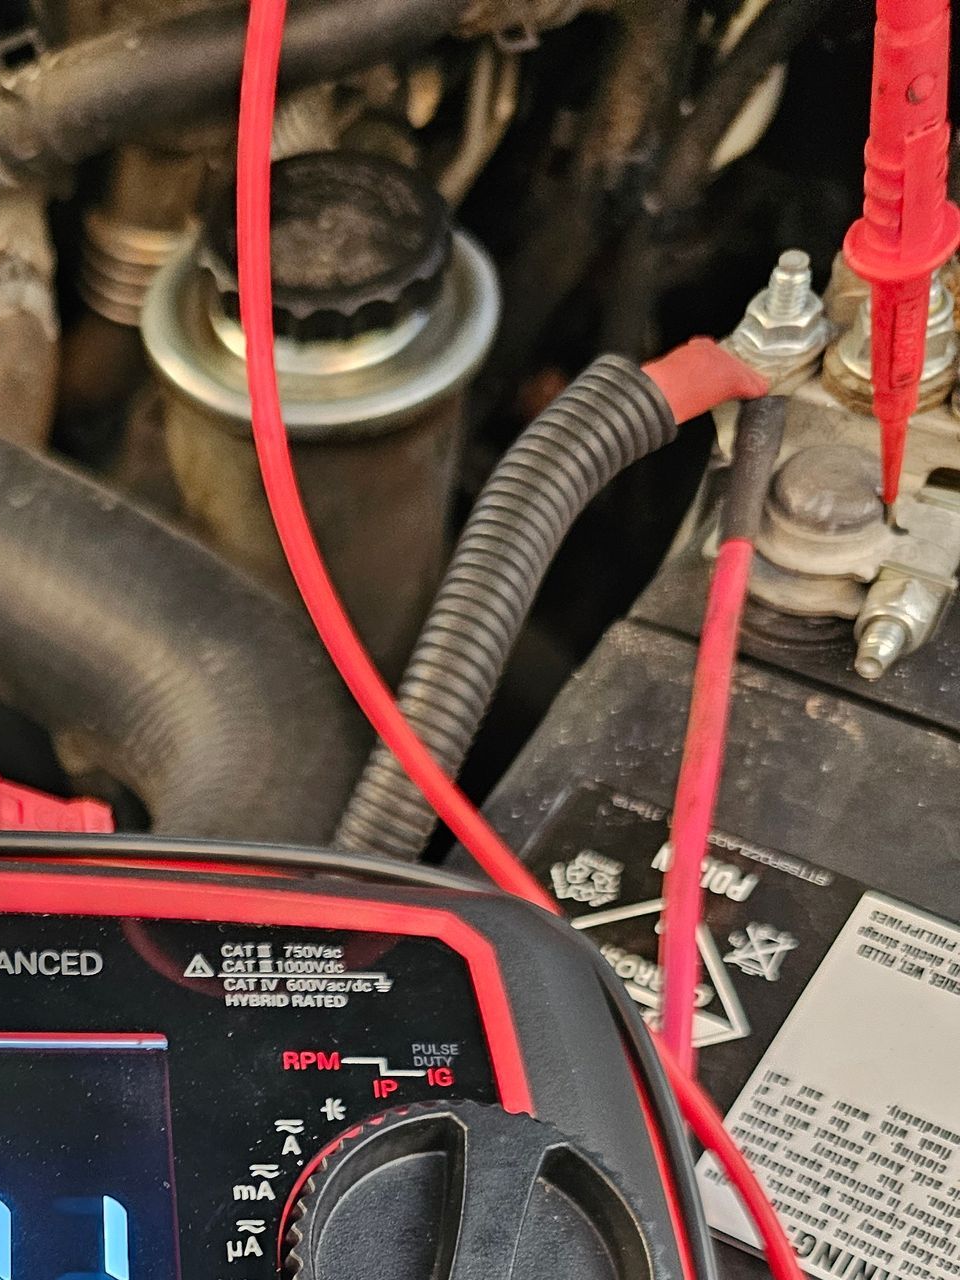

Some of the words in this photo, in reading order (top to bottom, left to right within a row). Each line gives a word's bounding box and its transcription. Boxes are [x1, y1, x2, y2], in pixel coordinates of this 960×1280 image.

[856, 924, 899, 951] storage
[868, 908, 957, 952] PHILIPPINES
[220, 943, 254, 958] CAT
[283, 945, 344, 959] 750Vac
[855, 942, 896, 968] FILLED
[898, 942, 944, 970] electric
[222, 960, 256, 974] CAT
[276, 960, 345, 974] 1000Vdc
[896, 958, 925, 979] WET,
[223, 978, 257, 992] CAT
[260, 979, 279, 992] IV
[286, 979, 373, 993] 600Vac/dc
[224, 993, 290, 1008] HYBRID
[291, 994, 349, 1009] RATED
[411, 1043, 459, 1055] PULSE
[283, 1051, 340, 1071] RPM
[413, 1056, 453, 1067] DUTY
[372, 1079, 399, 1098] IP
[426, 1067, 454, 1087] IG
[830, 1098, 869, 1124] water
[826, 1115, 850, 1134] the
[877, 1119, 908, 1142] with
[282, 1135, 302, 1155] A
[812, 1126, 864, 1157] contact
[809, 1141, 859, 1173] battery
[865, 1150, 905, 1176] Avoid
[232, 1180, 276, 1201] mA
[794, 1173, 831, 1198] When
[824, 1168, 883, 1202] enclosed
[875, 1172, 904, 1195] This
[816, 1201, 849, 1225] from
[900, 1202, 952, 1236] battery
[856, 1217, 892, 1243] away
[906, 1224, 956, 1256] lighted
[831, 1228, 893, 1264] batteries
